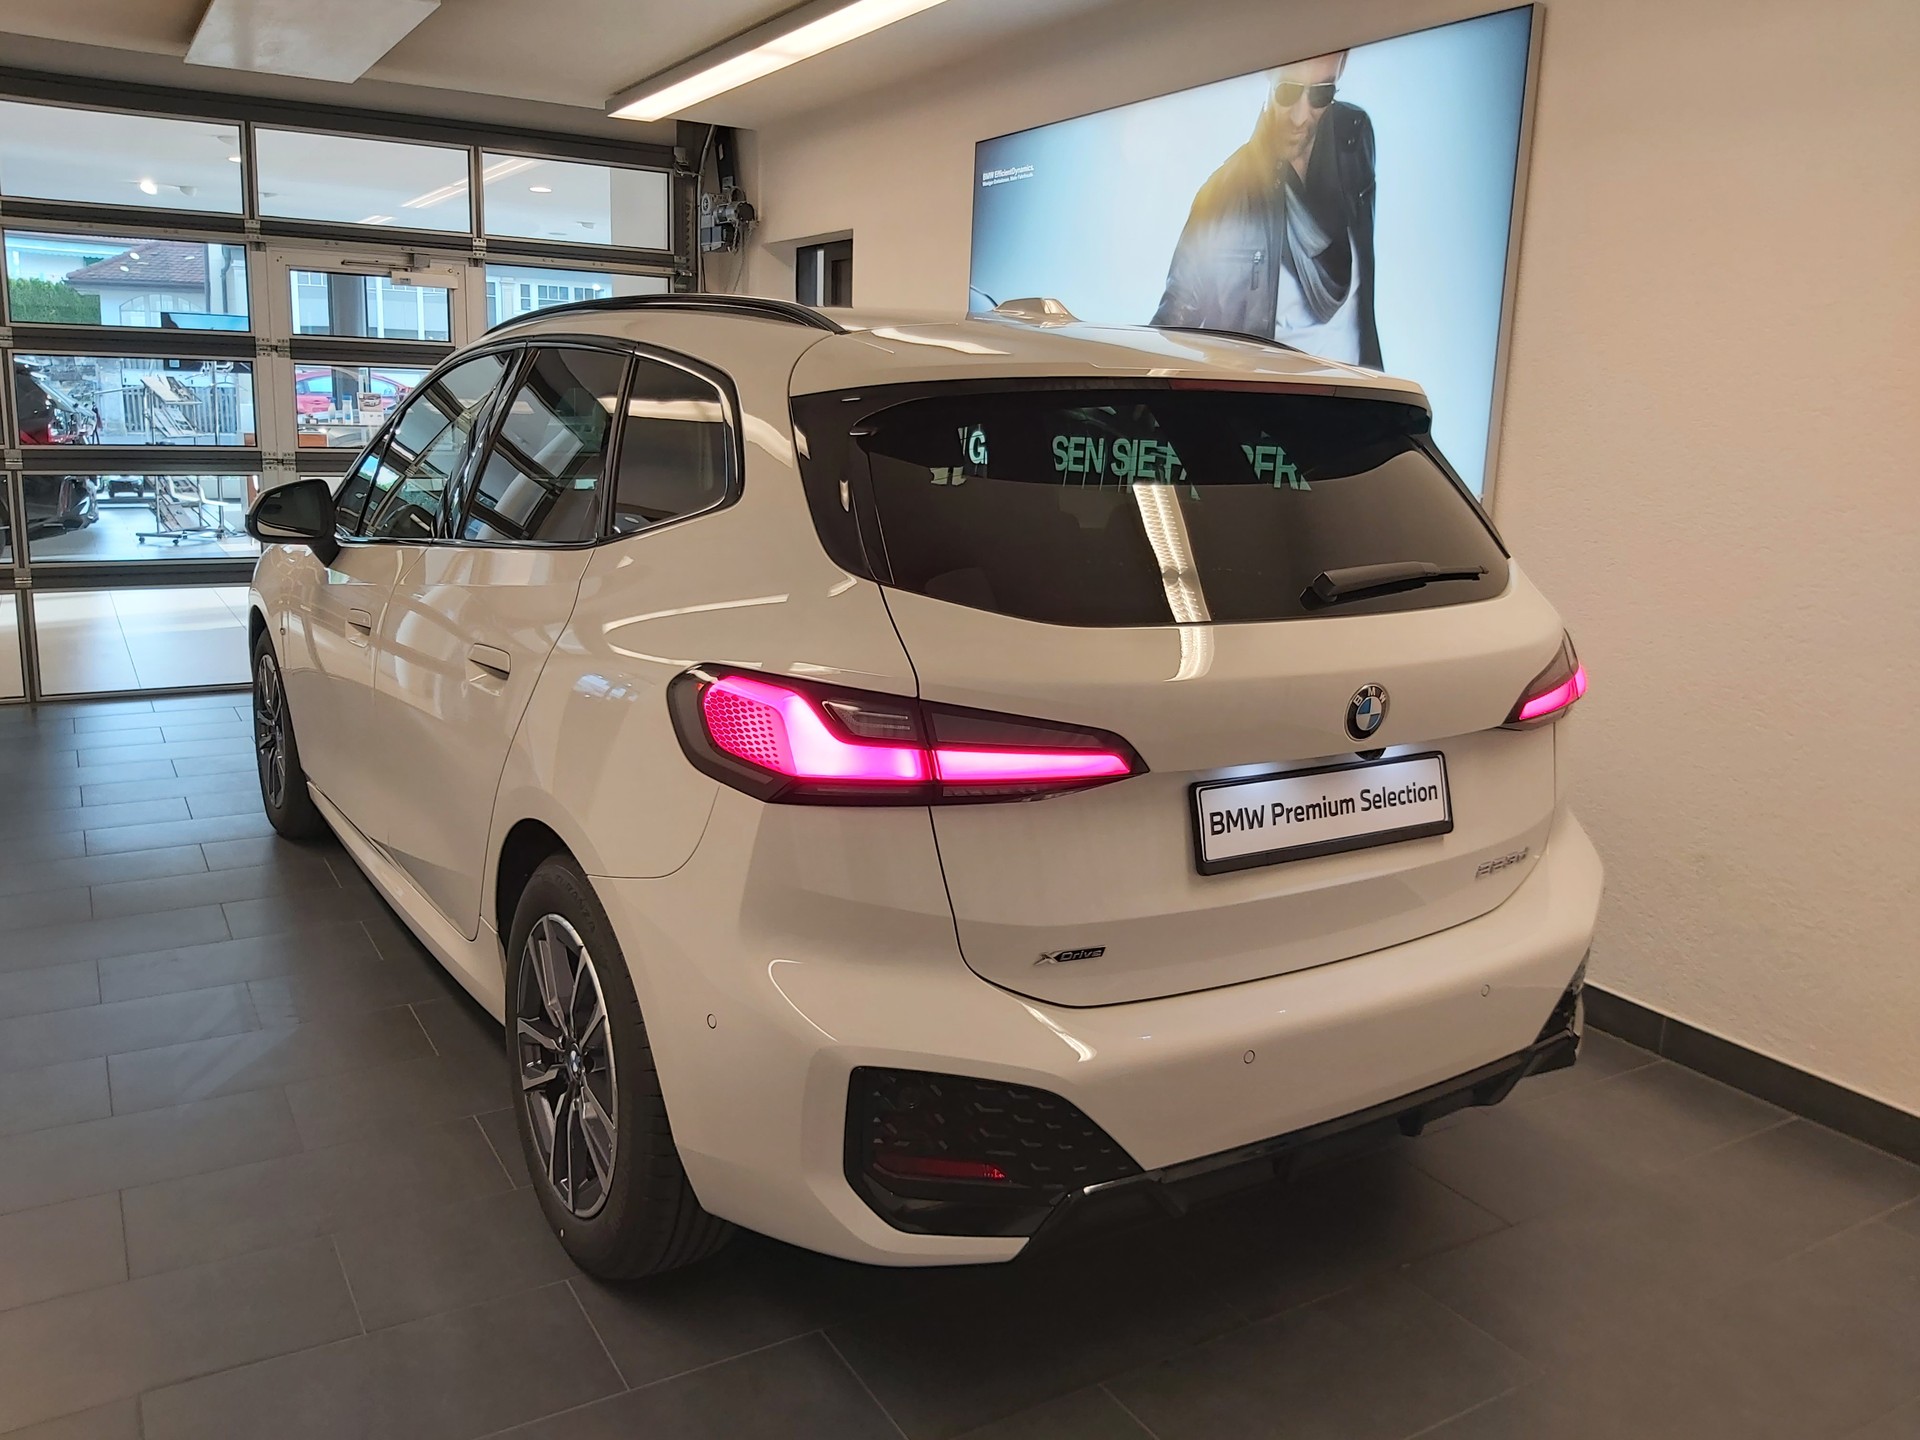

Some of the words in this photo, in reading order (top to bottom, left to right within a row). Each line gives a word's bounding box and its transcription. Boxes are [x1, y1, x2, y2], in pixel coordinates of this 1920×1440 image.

[1353, 686, 1387, 707] BMW
[1209, 804, 1265, 836] BMW
[1271, 796, 1356, 826] Premium
[1360, 782, 1438, 812] Selection
